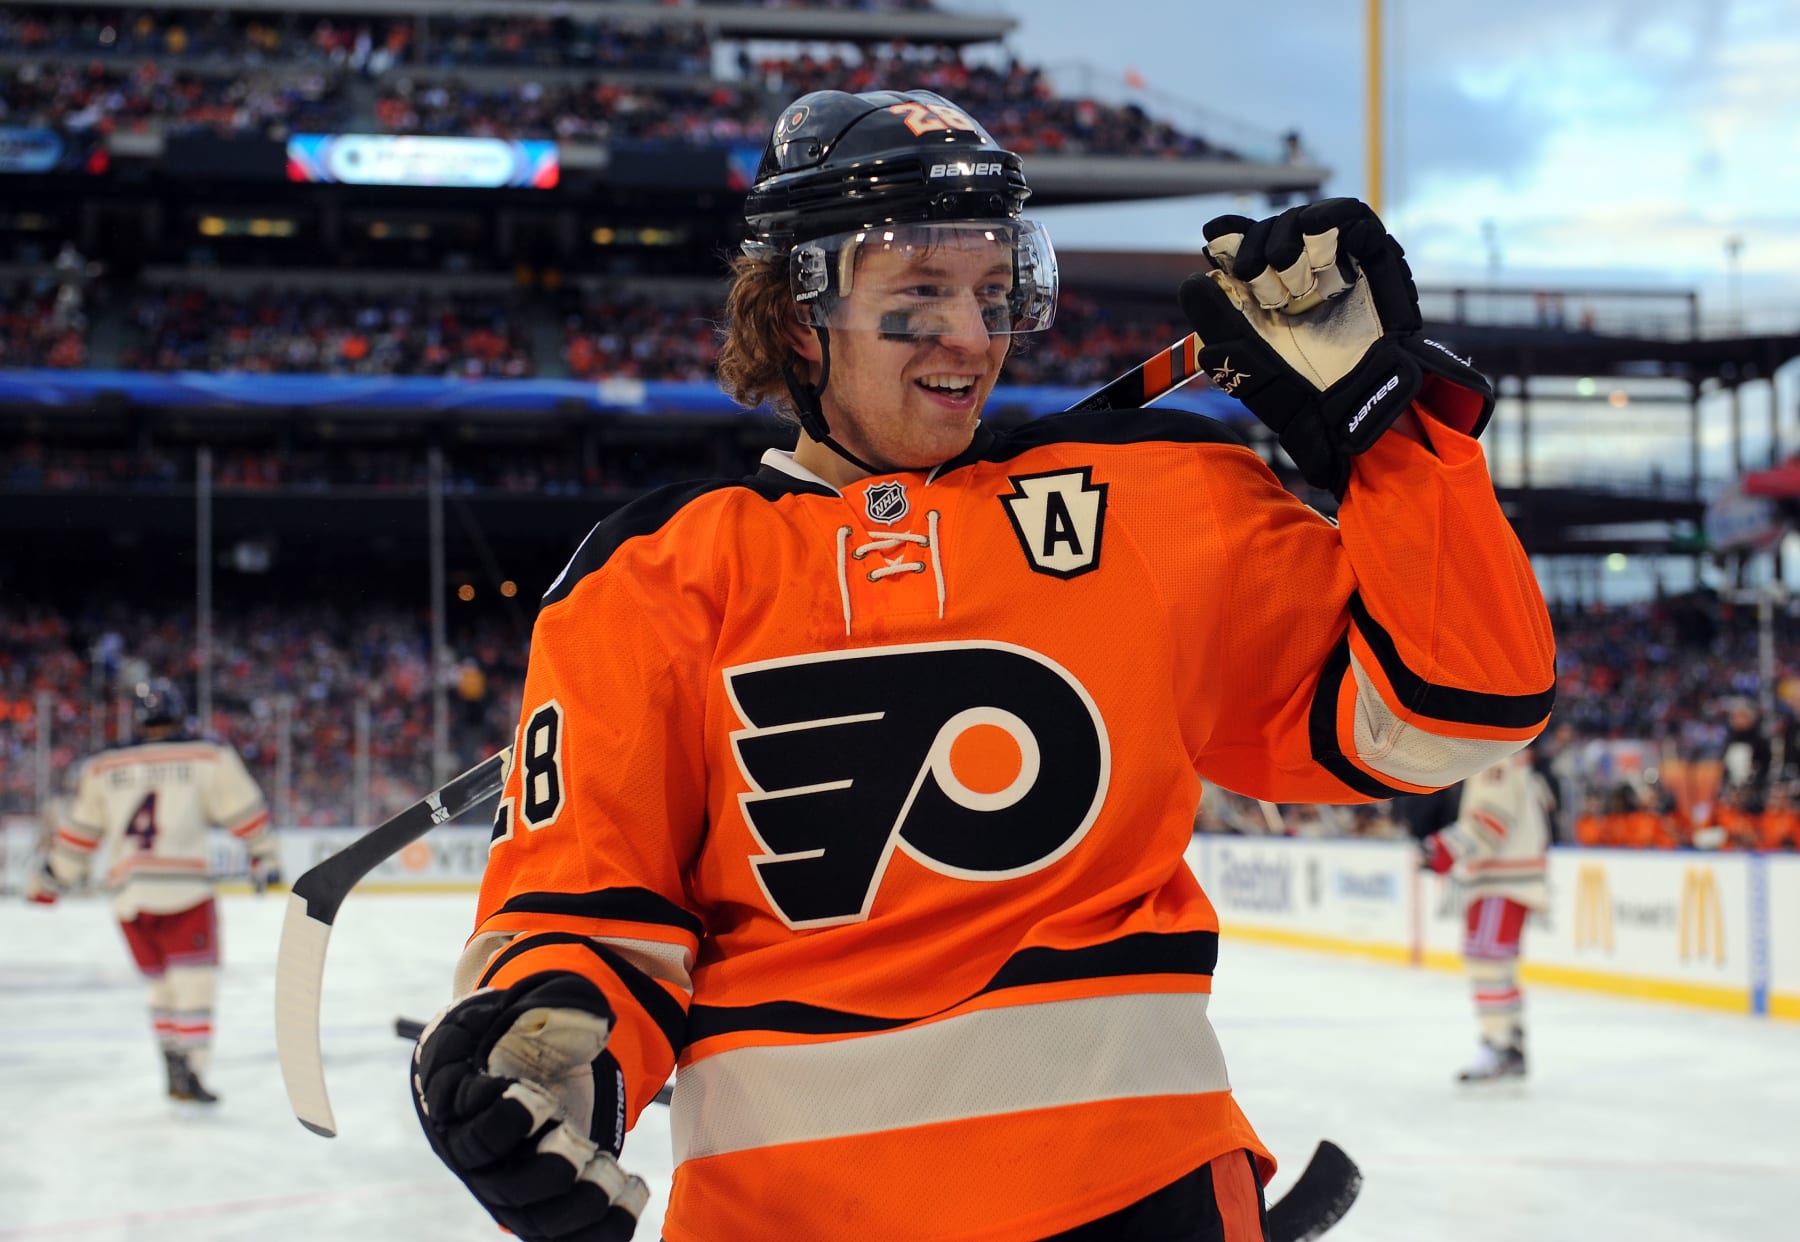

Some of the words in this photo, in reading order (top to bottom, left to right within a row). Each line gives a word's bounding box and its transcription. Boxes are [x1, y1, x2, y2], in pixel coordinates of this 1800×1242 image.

[929, 162, 1003, 178] BAUER
[1348, 375, 1399, 433] BAUER
[875, 491, 900, 516] NHL
[1042, 491, 1084, 556] A
[125, 787, 160, 851] 4
